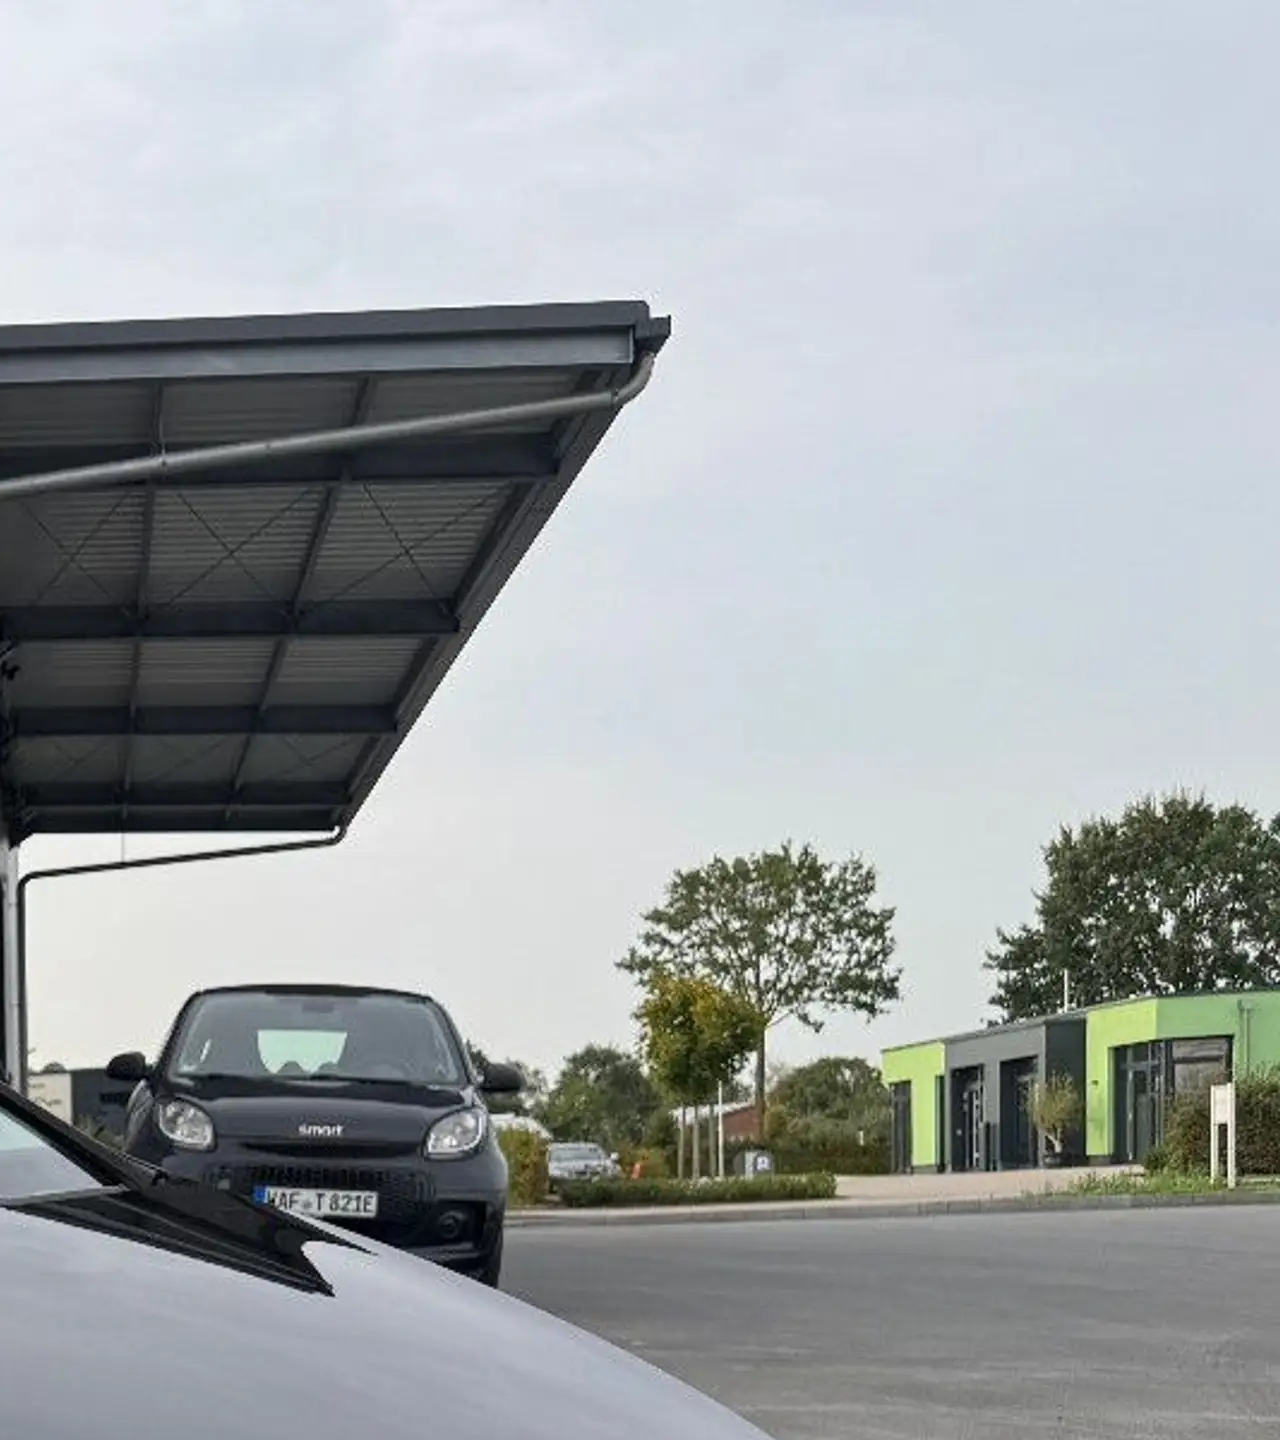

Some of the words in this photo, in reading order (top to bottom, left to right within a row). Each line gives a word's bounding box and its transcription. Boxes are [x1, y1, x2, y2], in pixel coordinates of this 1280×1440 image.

[298, 1123, 344, 1136] smart
[316, 1192, 325, 1211] T
[329, 1193, 375, 1213] 821E
